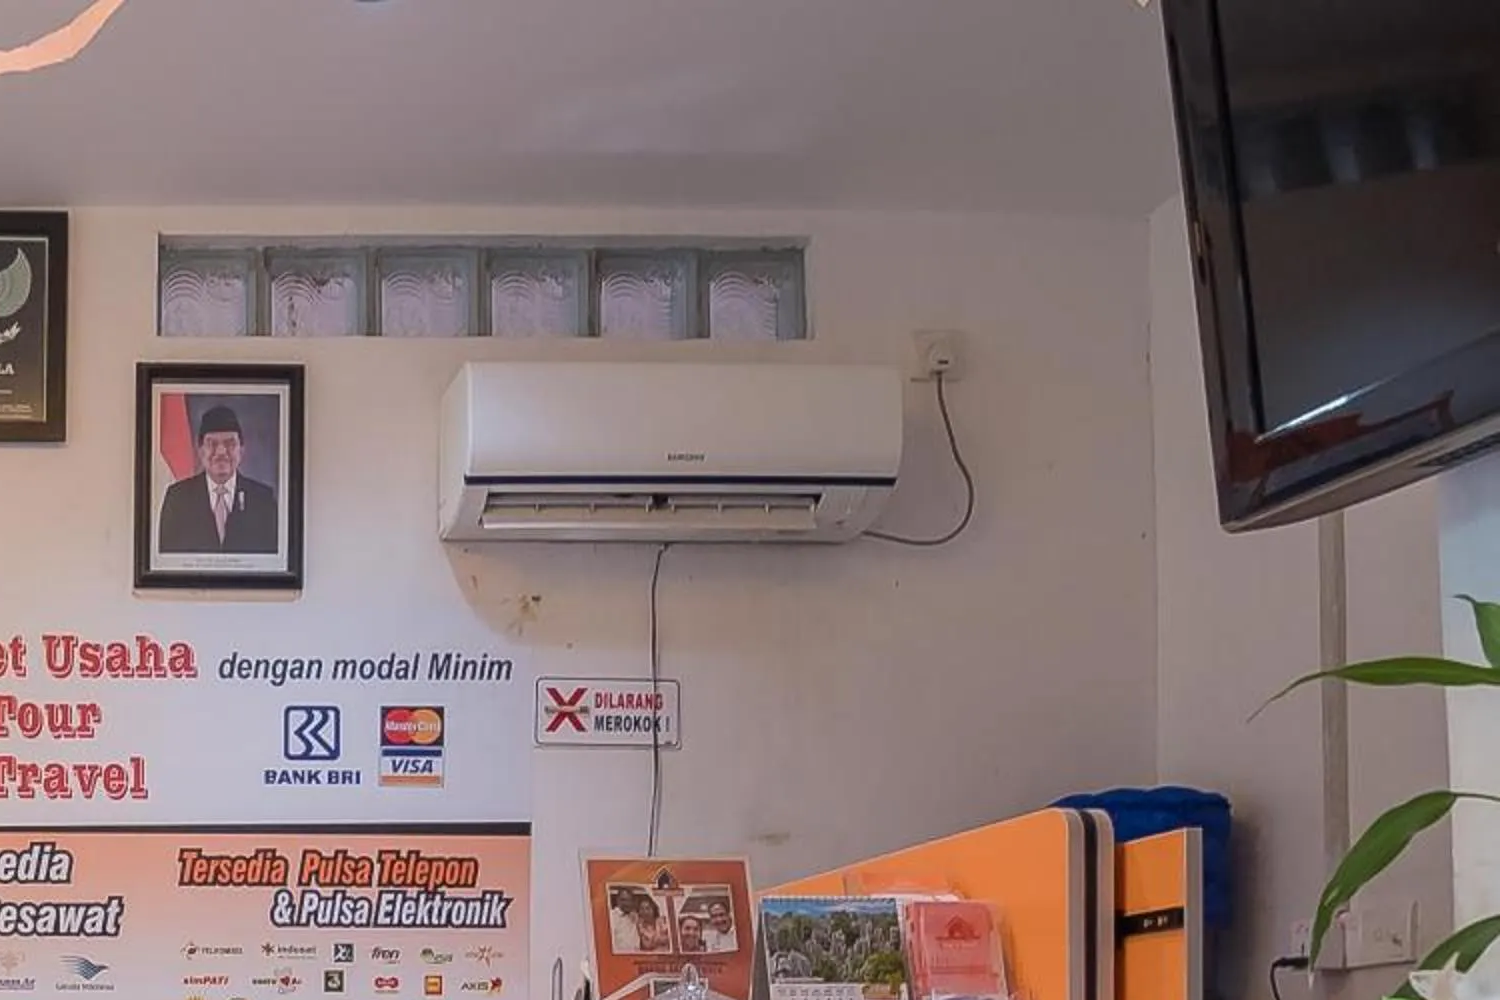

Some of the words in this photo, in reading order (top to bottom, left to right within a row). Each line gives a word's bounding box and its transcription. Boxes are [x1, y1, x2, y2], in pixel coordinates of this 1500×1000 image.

[42, 635, 198, 679] Usaha
[217, 652, 319, 687] dengan
[331, 653, 419, 682] modal
[427, 653, 514, 683] Minim
[594, 692, 664, 710] DILARANG
[594, 716, 662, 733] MEROKOK
[390, 759, 434, 774] VISA
[264, 769, 322, 786] BANK
[327, 770, 362, 786] BRI
[177, 848, 289, 887] Tersedia
[297, 849, 374, 887] Pulsa
[376, 850, 480, 891] Telepon
[271, 889, 299, 927] &
[299, 890, 374, 928] Pulsa
[373, 890, 514, 928] Elektronik
[461, 981, 489, 991] AXIS
